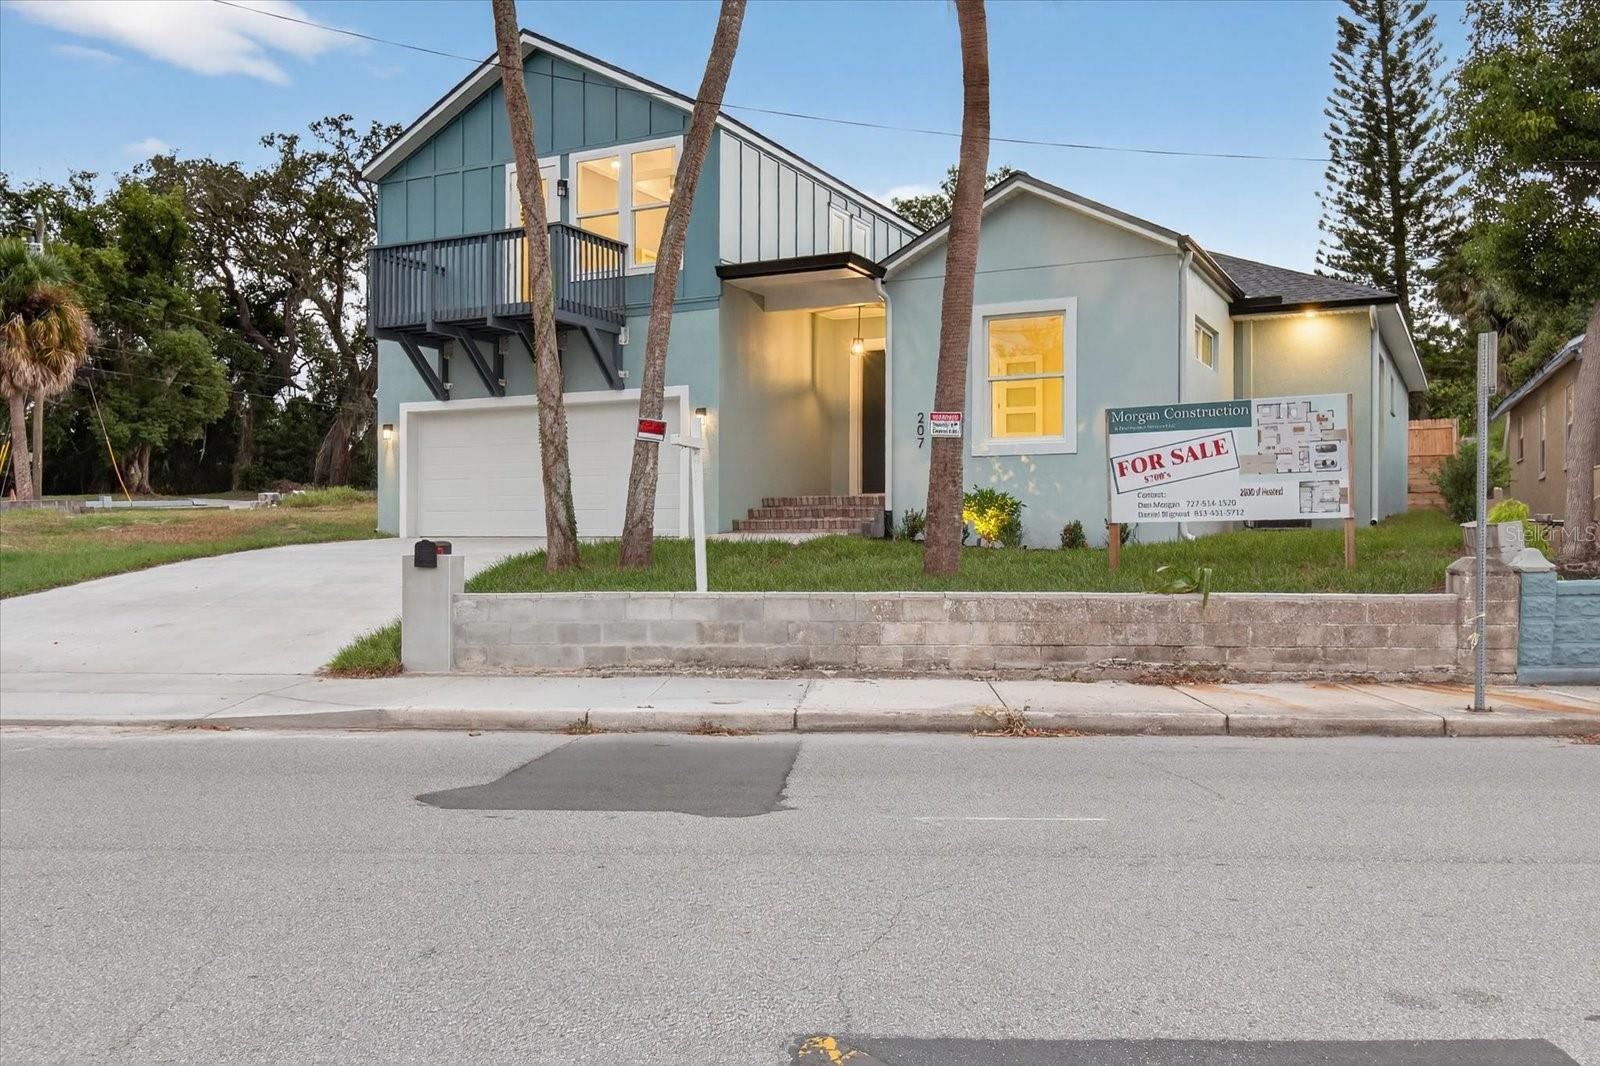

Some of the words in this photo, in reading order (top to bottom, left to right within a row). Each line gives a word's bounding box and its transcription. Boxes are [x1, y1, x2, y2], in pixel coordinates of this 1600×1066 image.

[1111, 410, 1160, 424] Morgan
[1164, 404, 1249, 419] Construction
[1116, 453, 1165, 477] FOR
[1170, 438, 1229, 465] SALE
